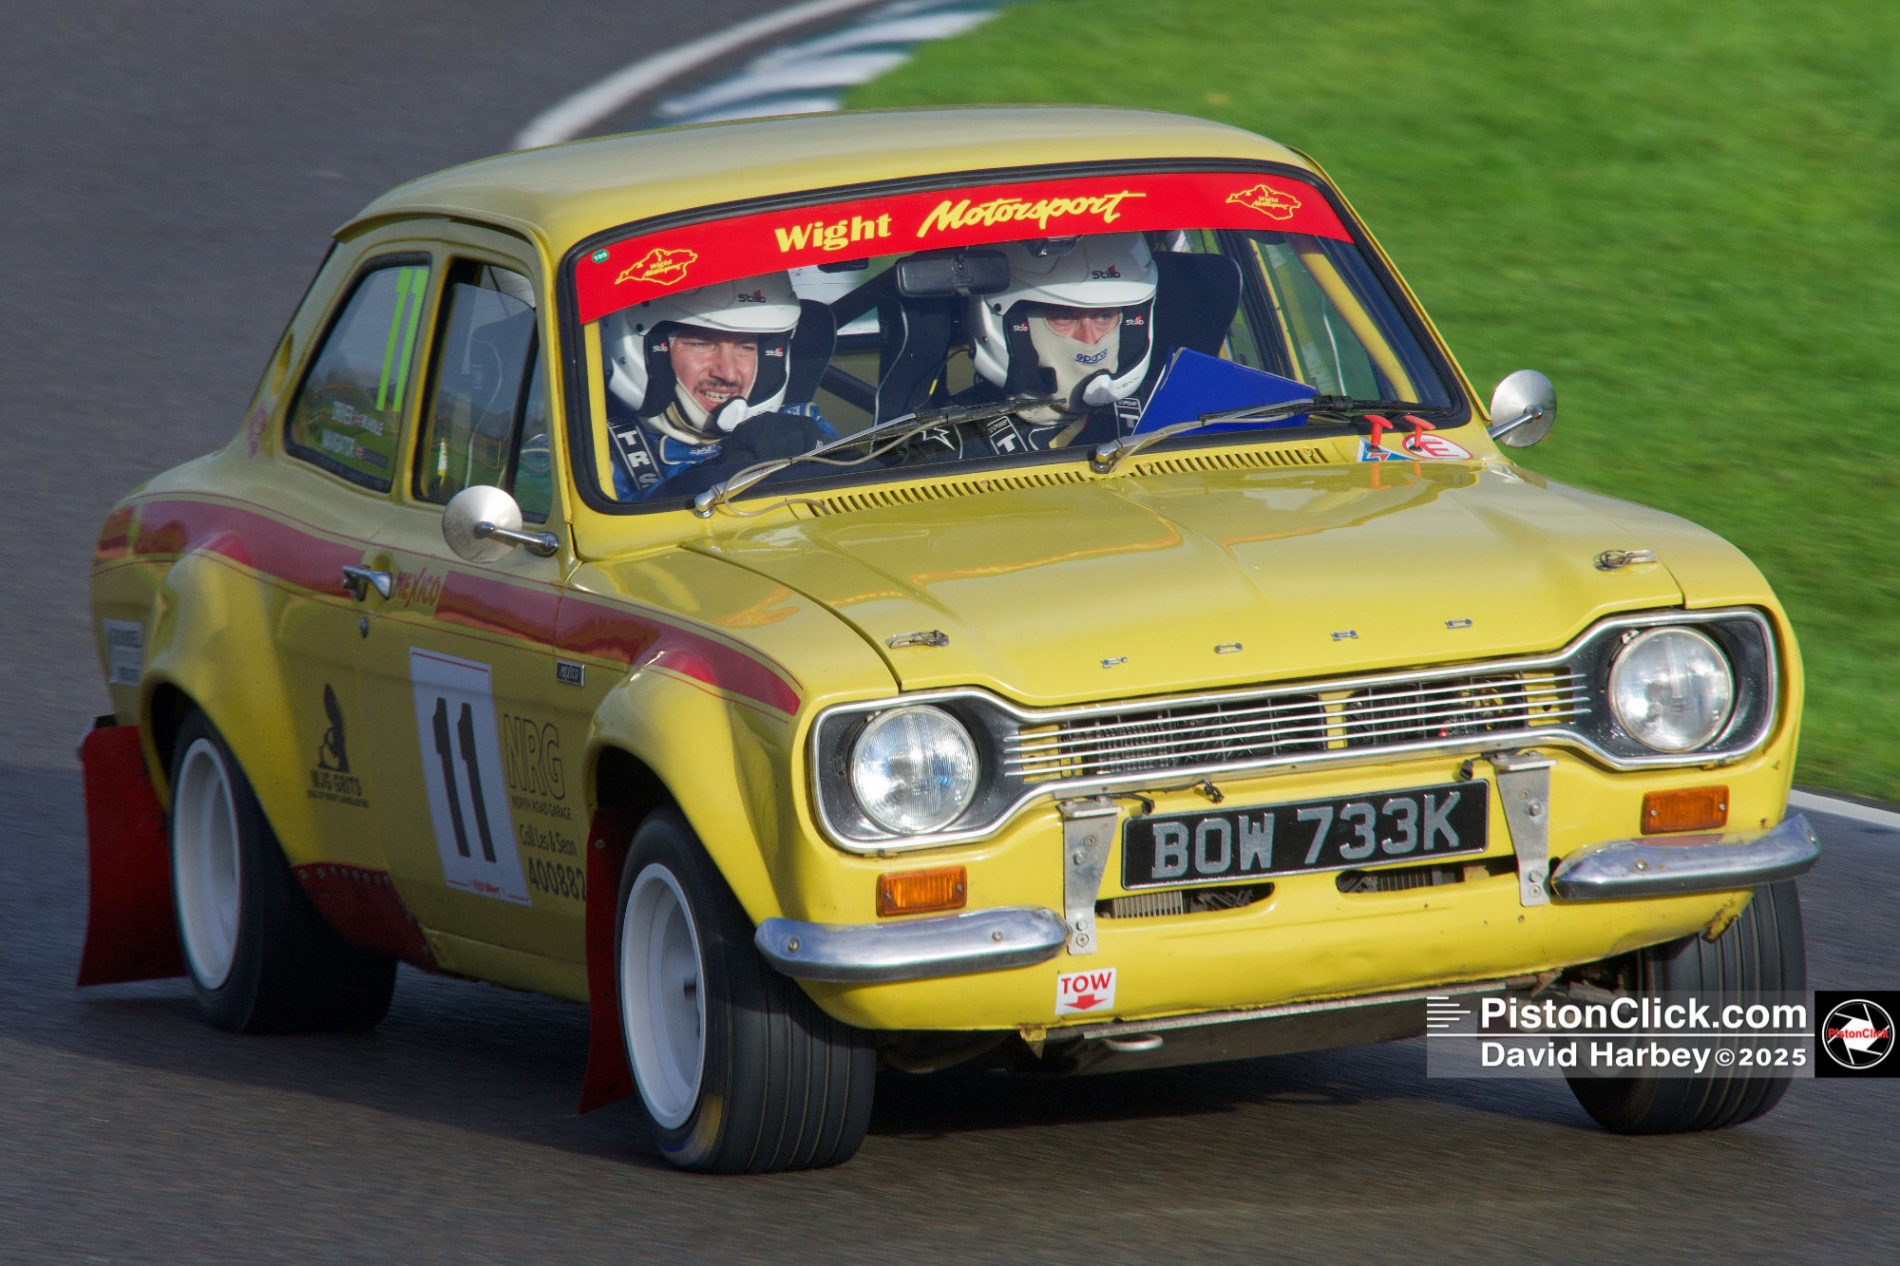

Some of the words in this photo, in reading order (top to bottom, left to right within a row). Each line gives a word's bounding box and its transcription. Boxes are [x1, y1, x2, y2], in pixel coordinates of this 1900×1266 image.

[775, 213, 892, 253] Wight
[917, 191, 1146, 237] Motorsport
[1091, 264, 1121, 280] Stilo
[376, 266, 430, 412] 11
[1125, 315, 1145, 327] Stilo
[433, 697, 497, 864] 11
[503, 714, 566, 800] NRG
[1151, 813, 1275, 878] BOW
[1297, 791, 1462, 865] 733K
[1061, 971, 1113, 995] TOW
